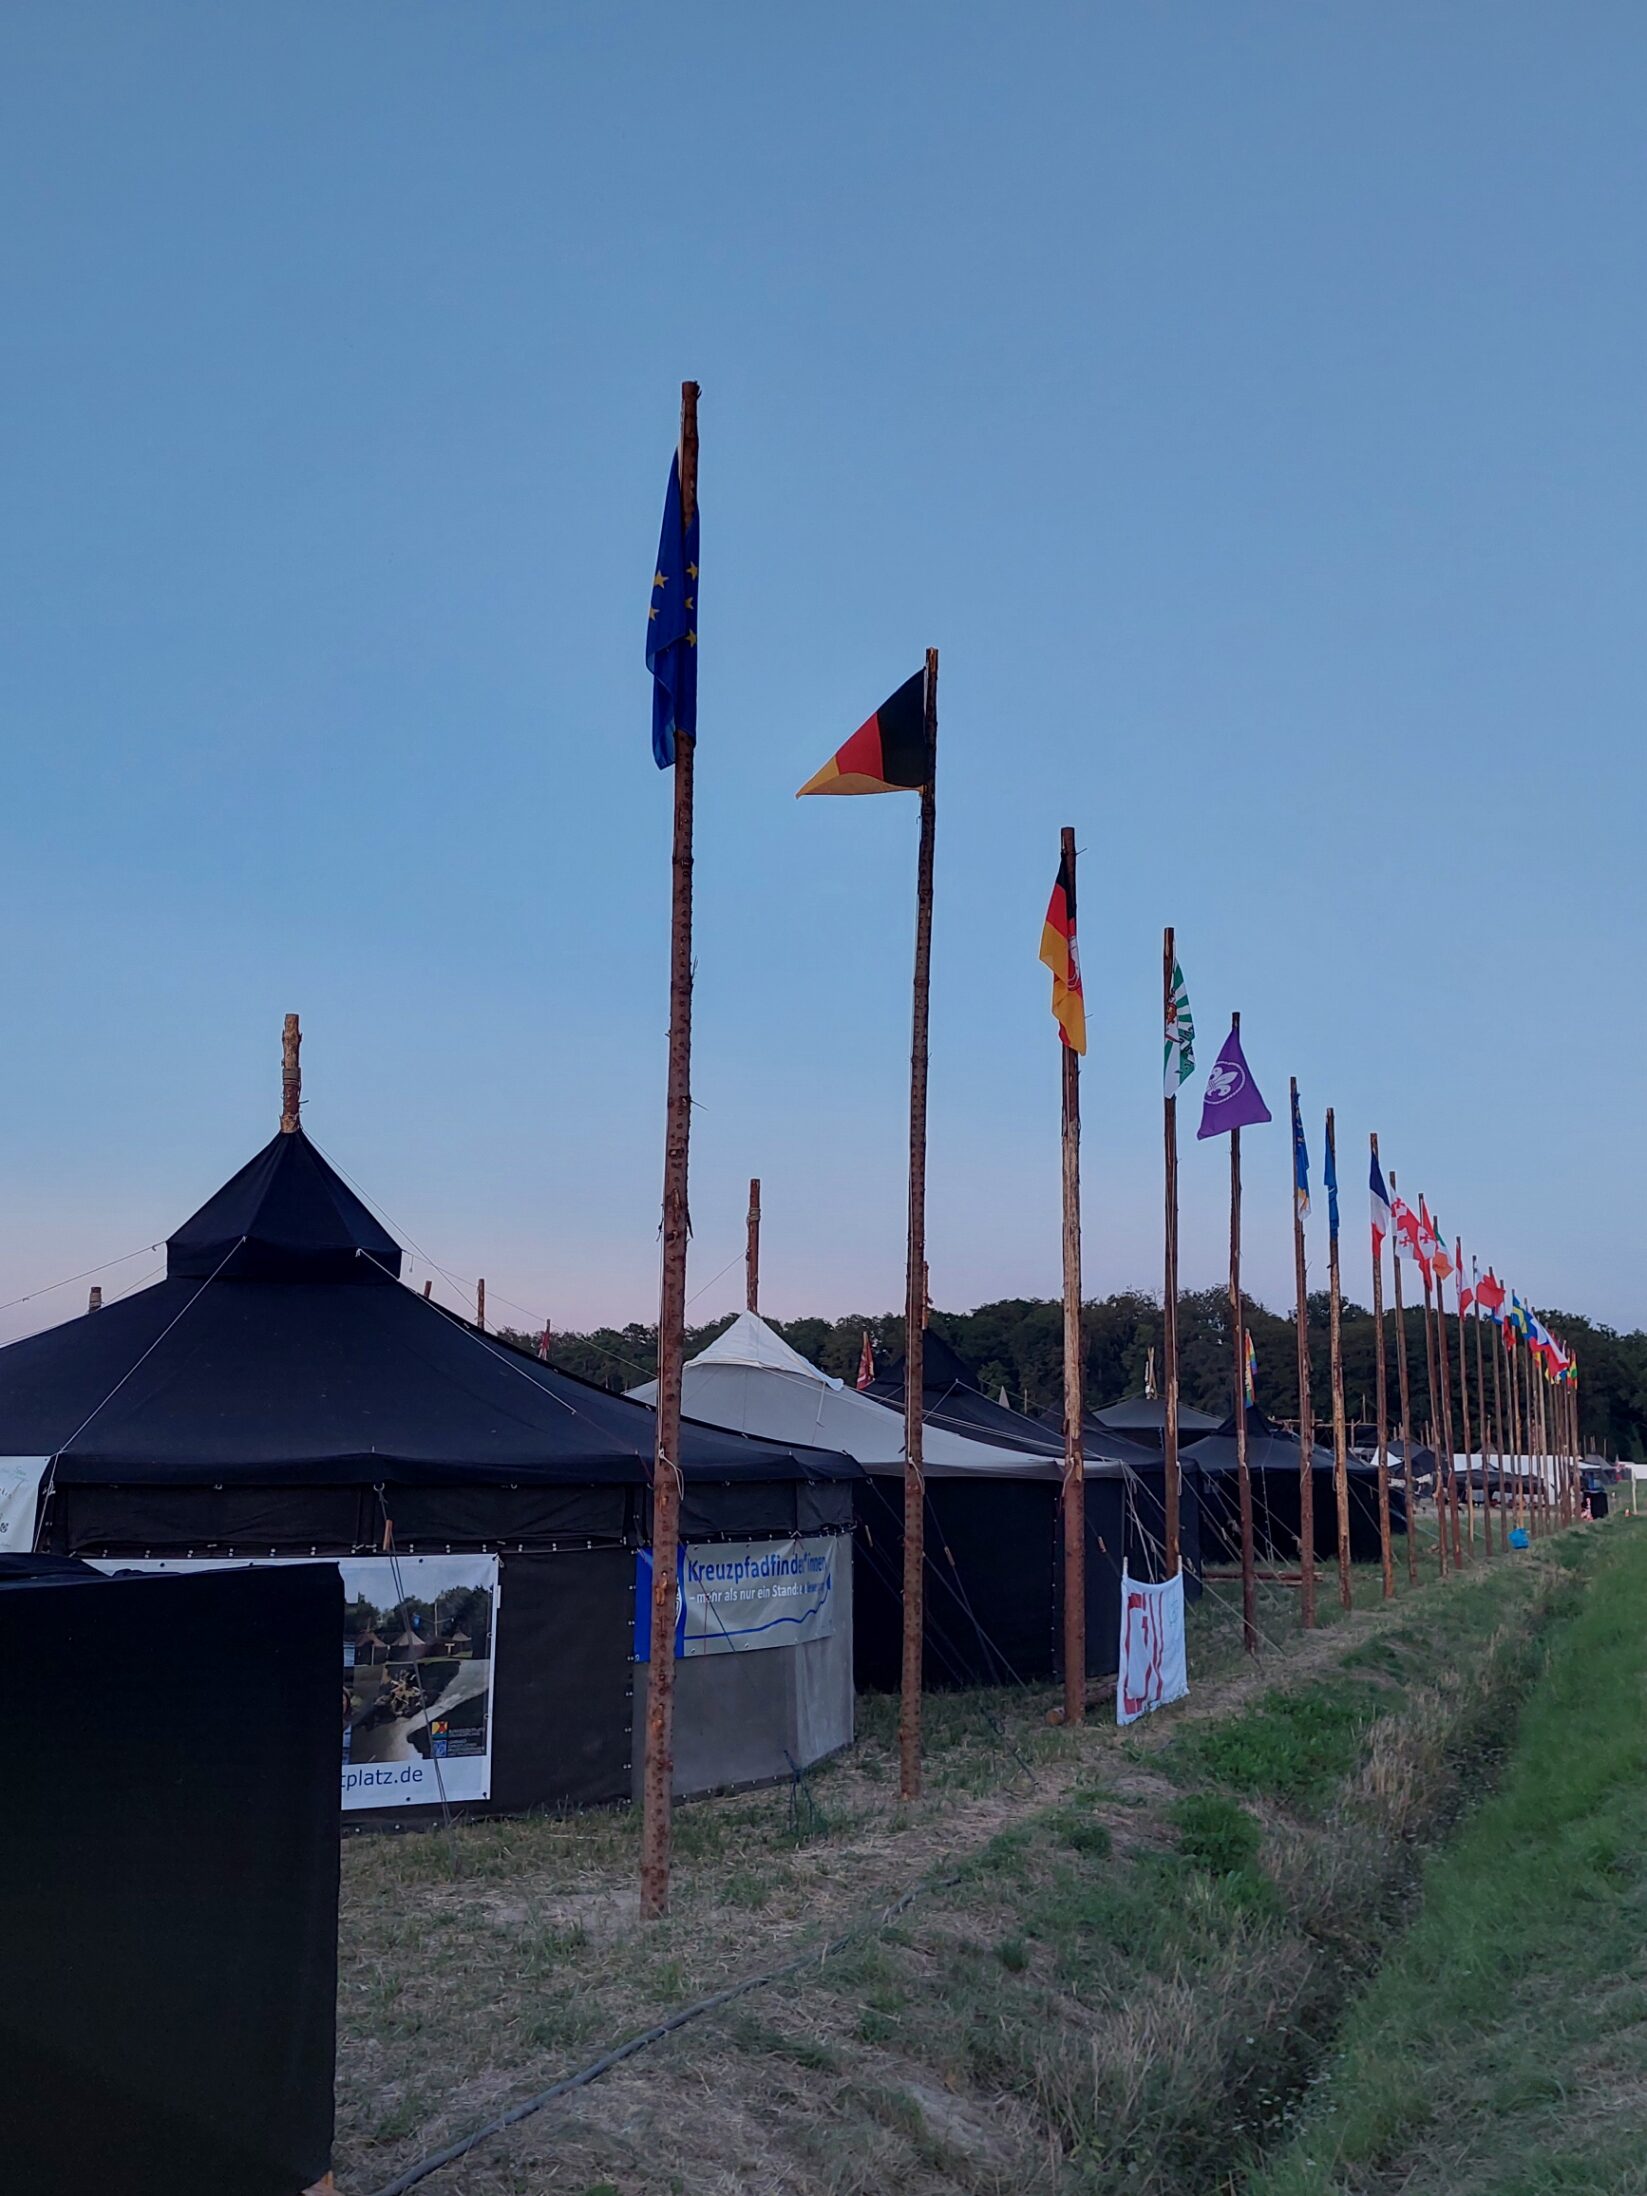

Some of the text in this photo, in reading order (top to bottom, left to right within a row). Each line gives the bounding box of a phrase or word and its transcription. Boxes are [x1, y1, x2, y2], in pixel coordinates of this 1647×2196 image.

[724, 1587, 738, 1602] als
[740, 1588, 756, 1601] nur
[757, 1585, 770, 1599] ein
